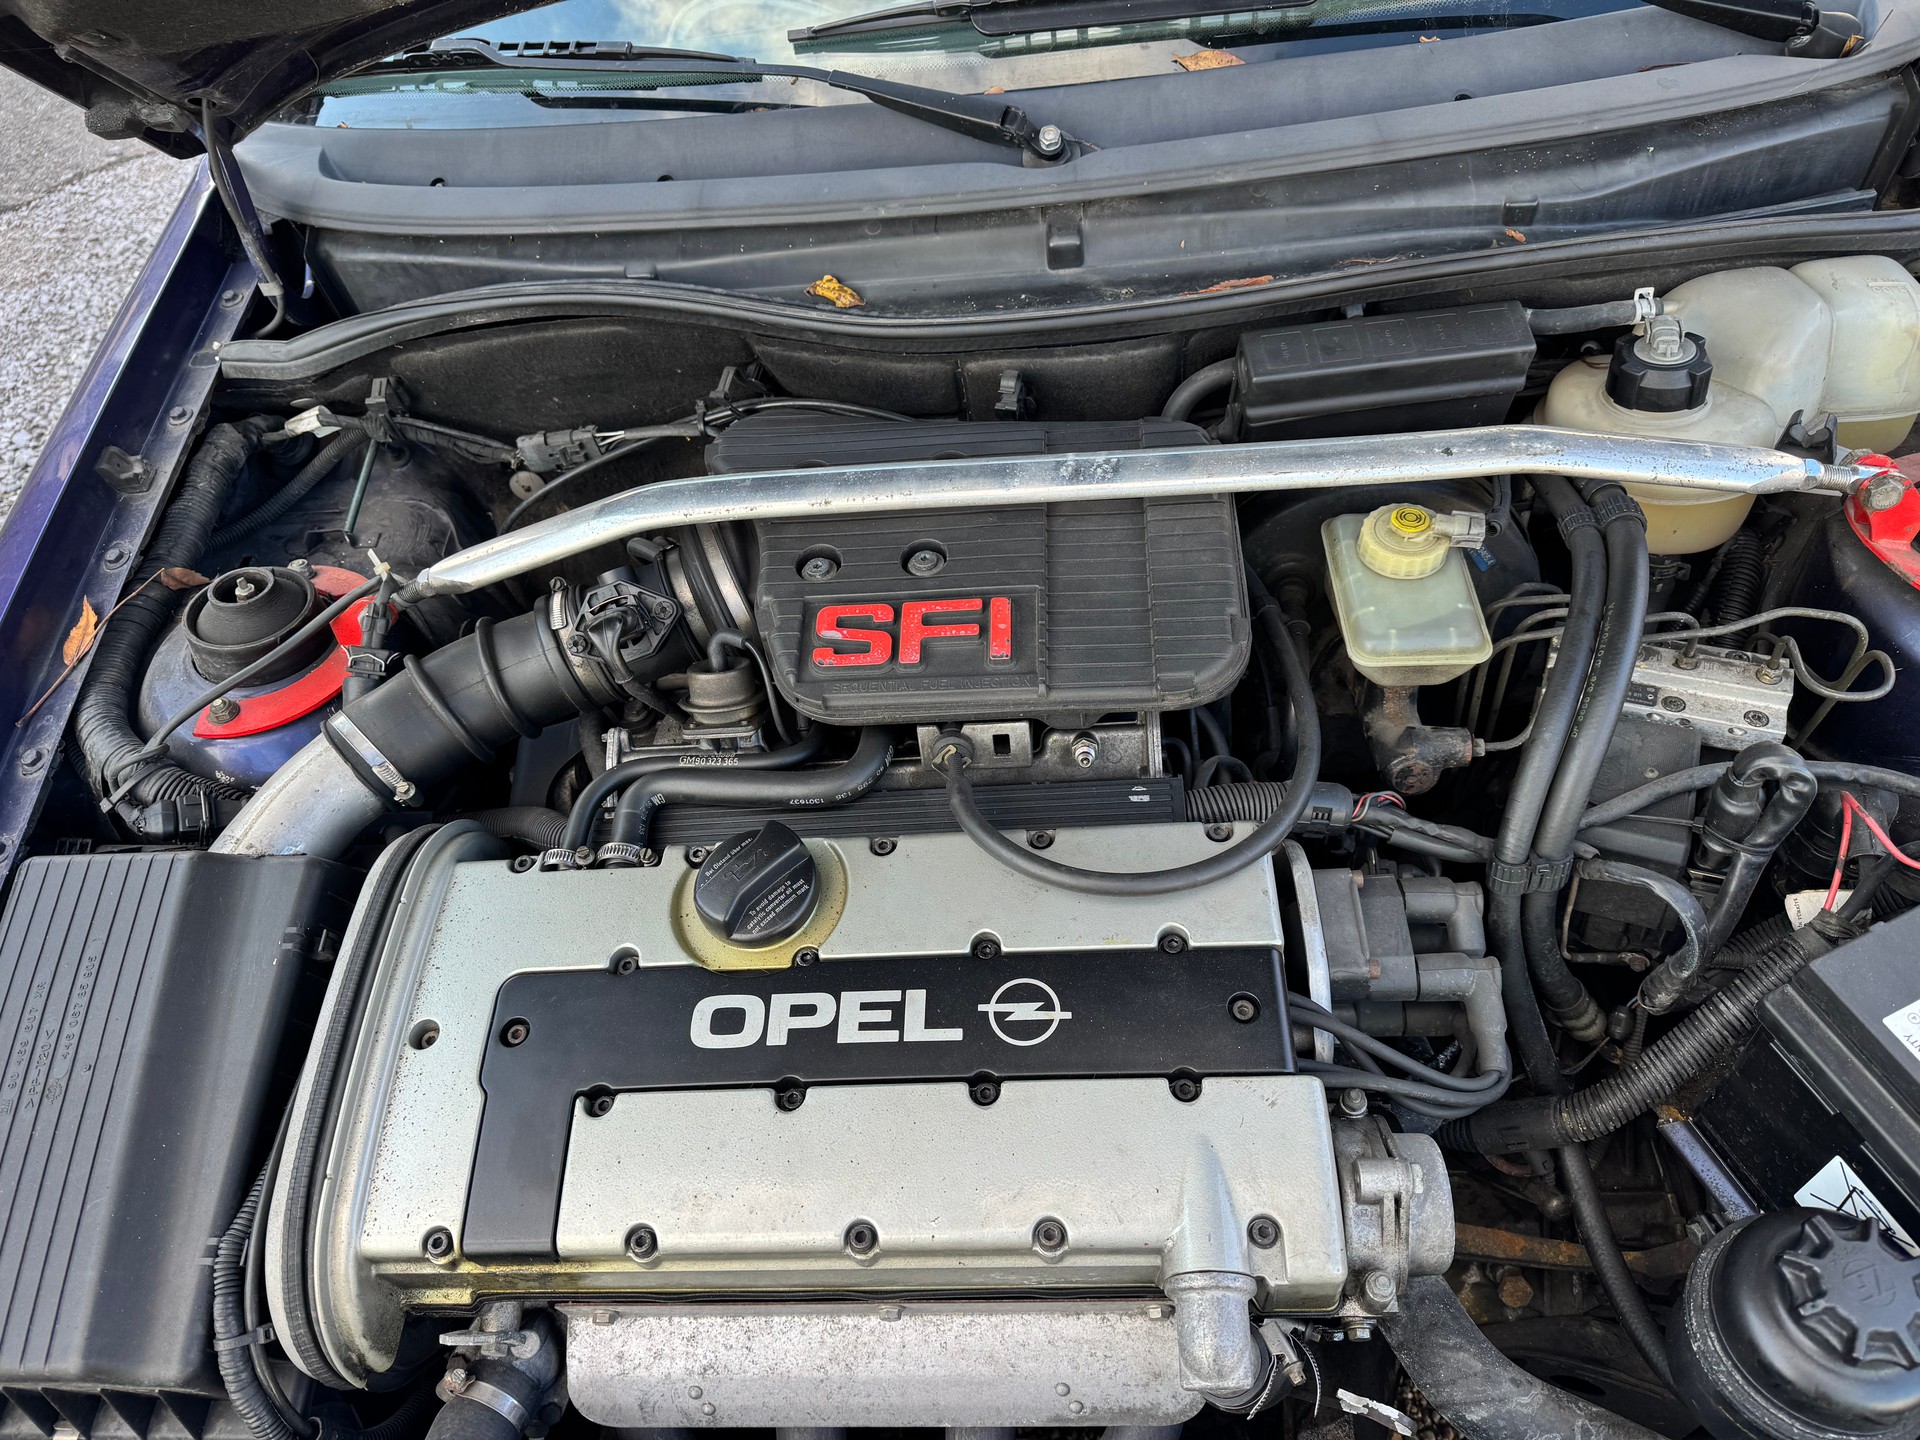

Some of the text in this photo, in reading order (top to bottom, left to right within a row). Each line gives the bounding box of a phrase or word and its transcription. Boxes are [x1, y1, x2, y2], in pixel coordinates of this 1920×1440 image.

[813, 596, 1012, 666] SFI
[832, 675, 1032, 694] SEQUENTIAL FUEL INJECTION
[706, 757, 722, 766] 323
[722, 757, 739, 766] 365
[650, 793, 666, 807] GM
[746, 910, 766, 930] catalytic
[765, 893, 787, 912] converter
[791, 879, 806, 890] must
[748, 909, 757, 917] To
[756, 899, 769, 911] avoid
[767, 885, 786, 901] damage
[752, 884, 810, 935] not exceed maximum mark
[691, 989, 964, 1049] OPEL
